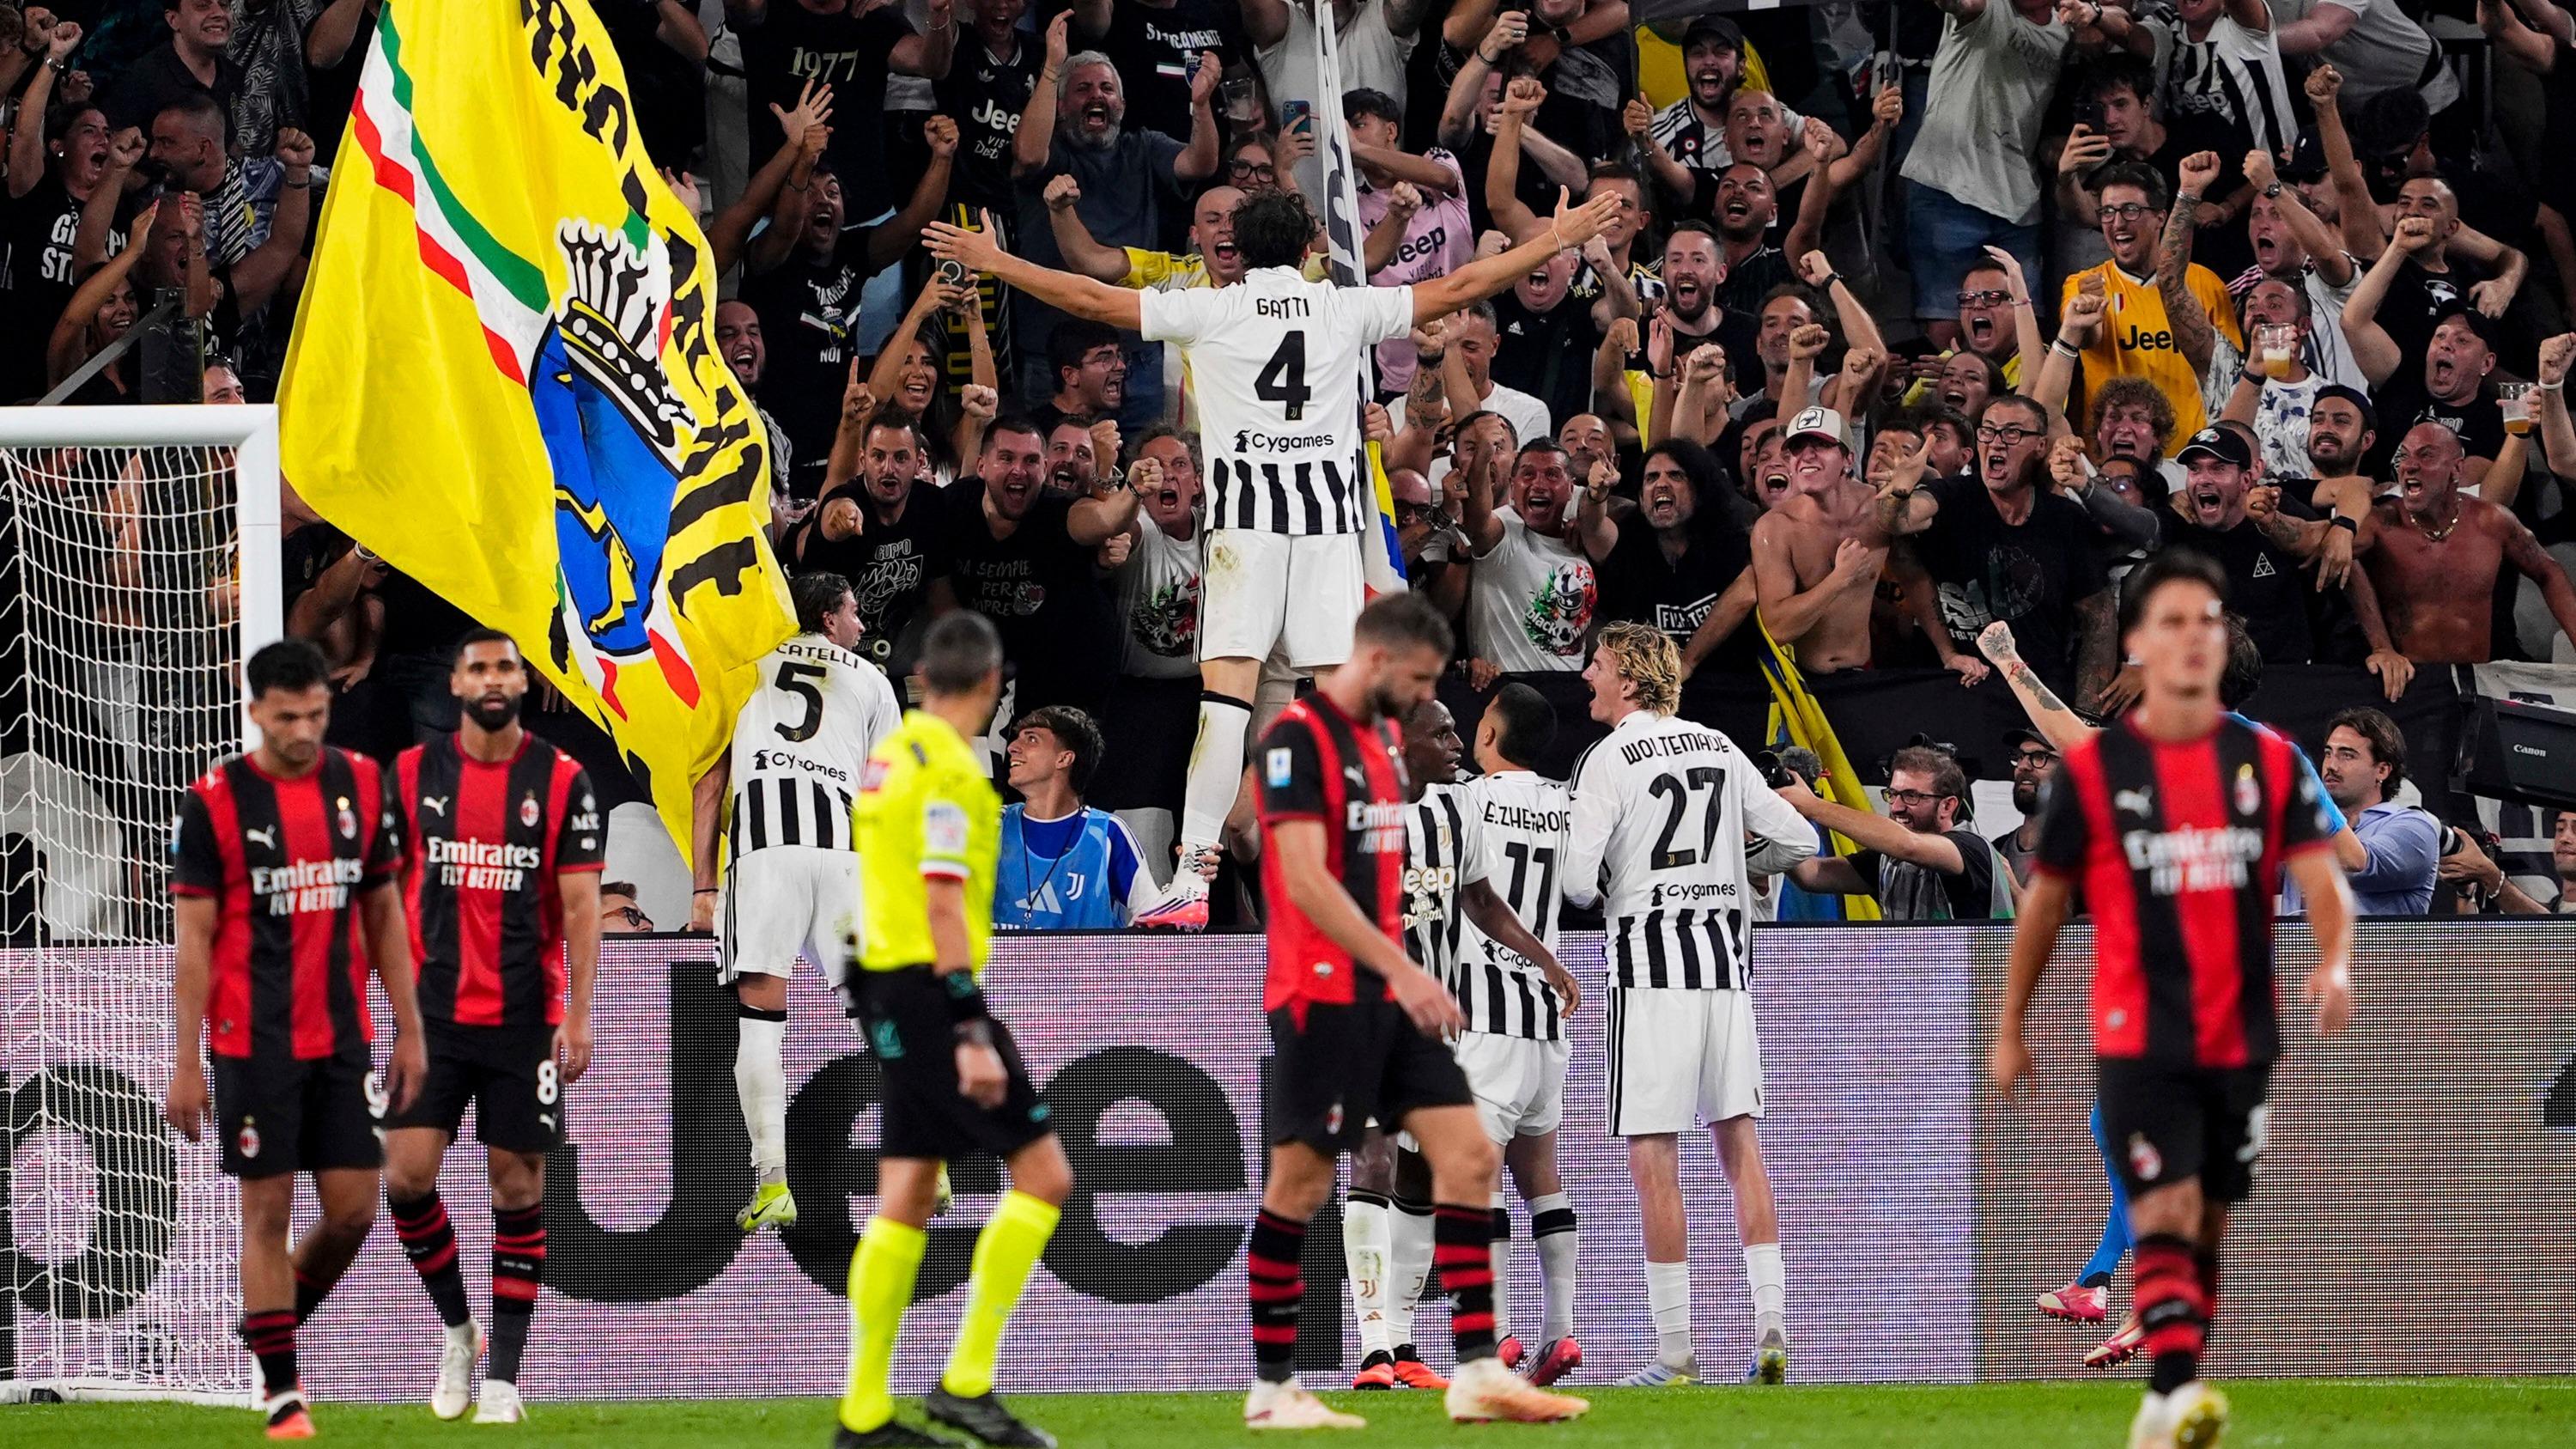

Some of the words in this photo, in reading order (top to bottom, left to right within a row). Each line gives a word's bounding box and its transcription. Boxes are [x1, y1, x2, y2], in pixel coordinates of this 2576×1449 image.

[787, 46, 859, 83] 1977
[972, 98, 1021, 134] Jee
[987, 135, 1010, 149] VIS
[1256, 297, 1310, 320] GATTI
[820, 346, 841, 363] NOI
[1254, 330, 1311, 421] 4
[1252, 432, 1334, 453] Cygames
[1525, 606, 1558, 637] black
[775, 642, 859, 669] CATELLI
[775, 661, 827, 743] 5
[1621, 732, 1730, 765] WOLTEMADE
[2513, 743, 2547, 758] Canon
[1648, 766, 1726, 871] 27
[428, 836, 541, 870] Emirates
[440, 865, 466, 887] FLY
[467, 868, 524, 892] BETTER
[1402, 865, 1456, 898] eep
[1504, 841, 1554, 944] 11
[1667, 882, 1736, 901] Cygames
[536, 1059, 559, 1105] 8
